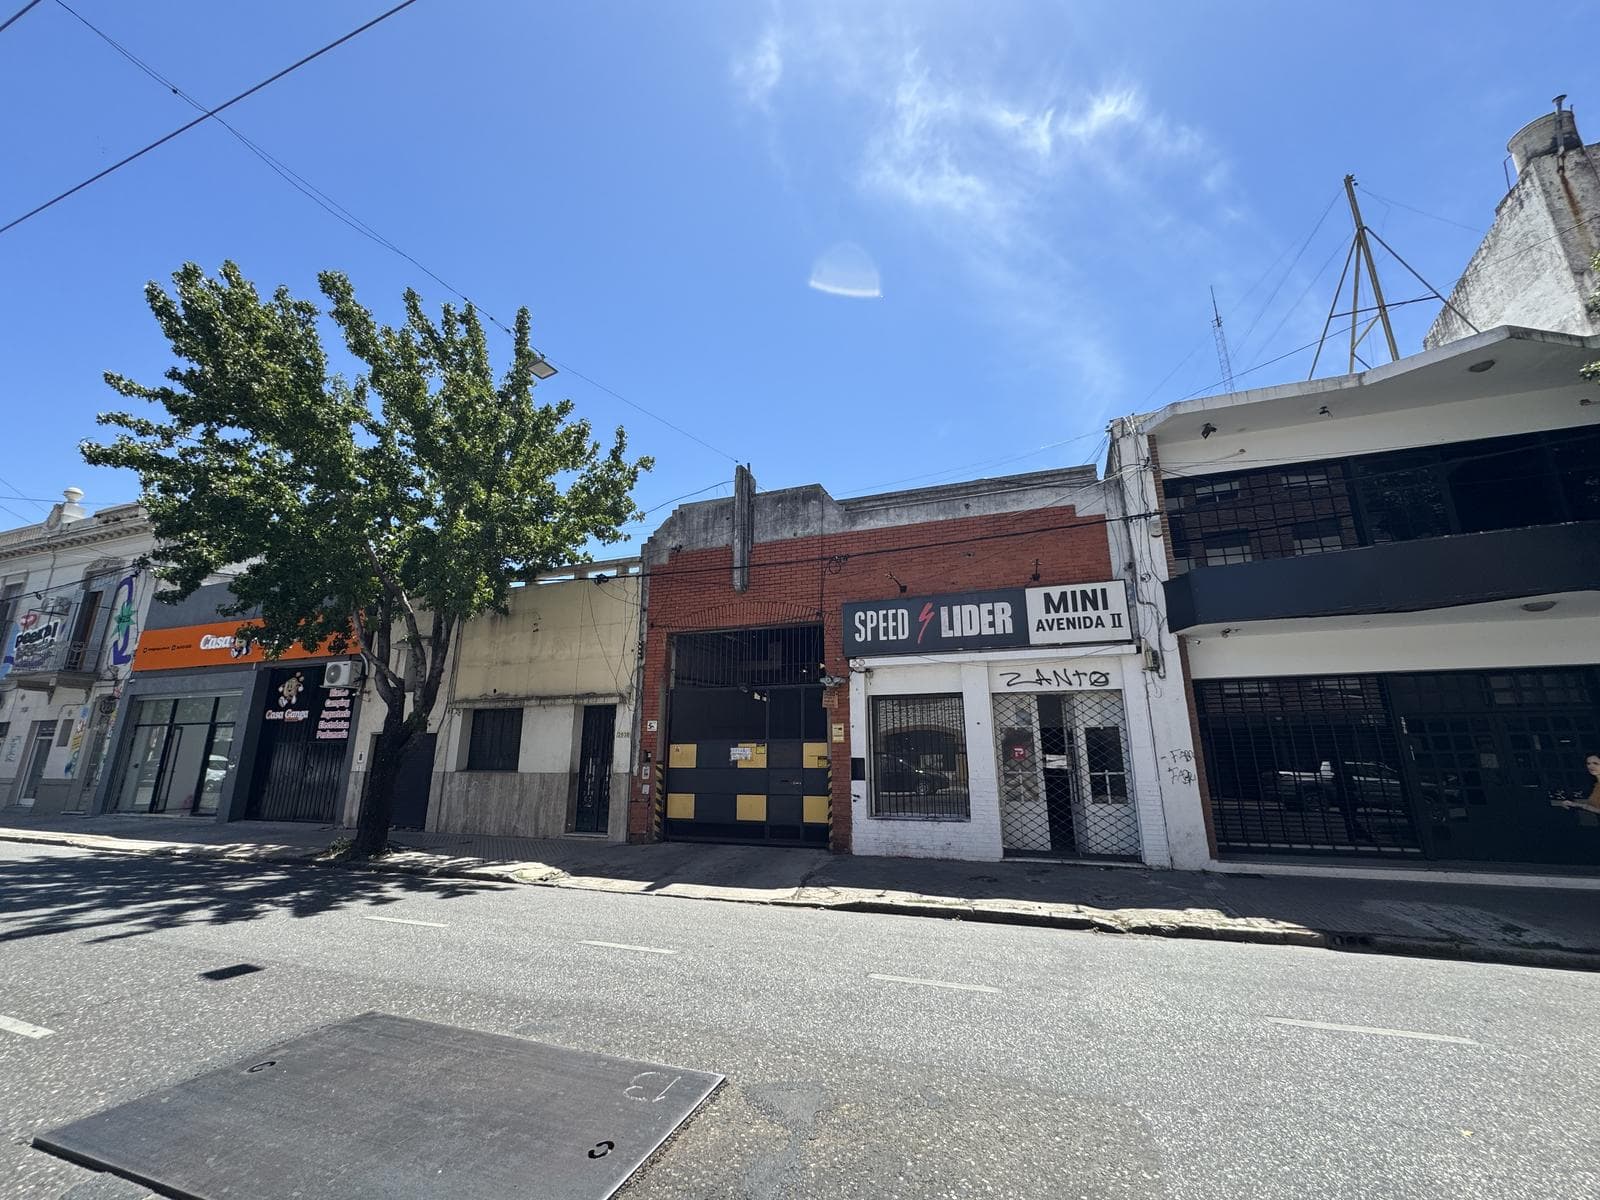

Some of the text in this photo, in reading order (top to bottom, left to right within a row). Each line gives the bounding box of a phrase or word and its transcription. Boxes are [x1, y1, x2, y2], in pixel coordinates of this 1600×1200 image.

[1043, 588, 1109, 614] MINI
[854, 602, 1013, 642] SPEED LIDER
[1036, 613, 1124, 632] AVENIDA II
[199, 634, 233, 650] Casa
[265, 709, 284, 720] Casa
[285, 708, 310, 721] Ganga
